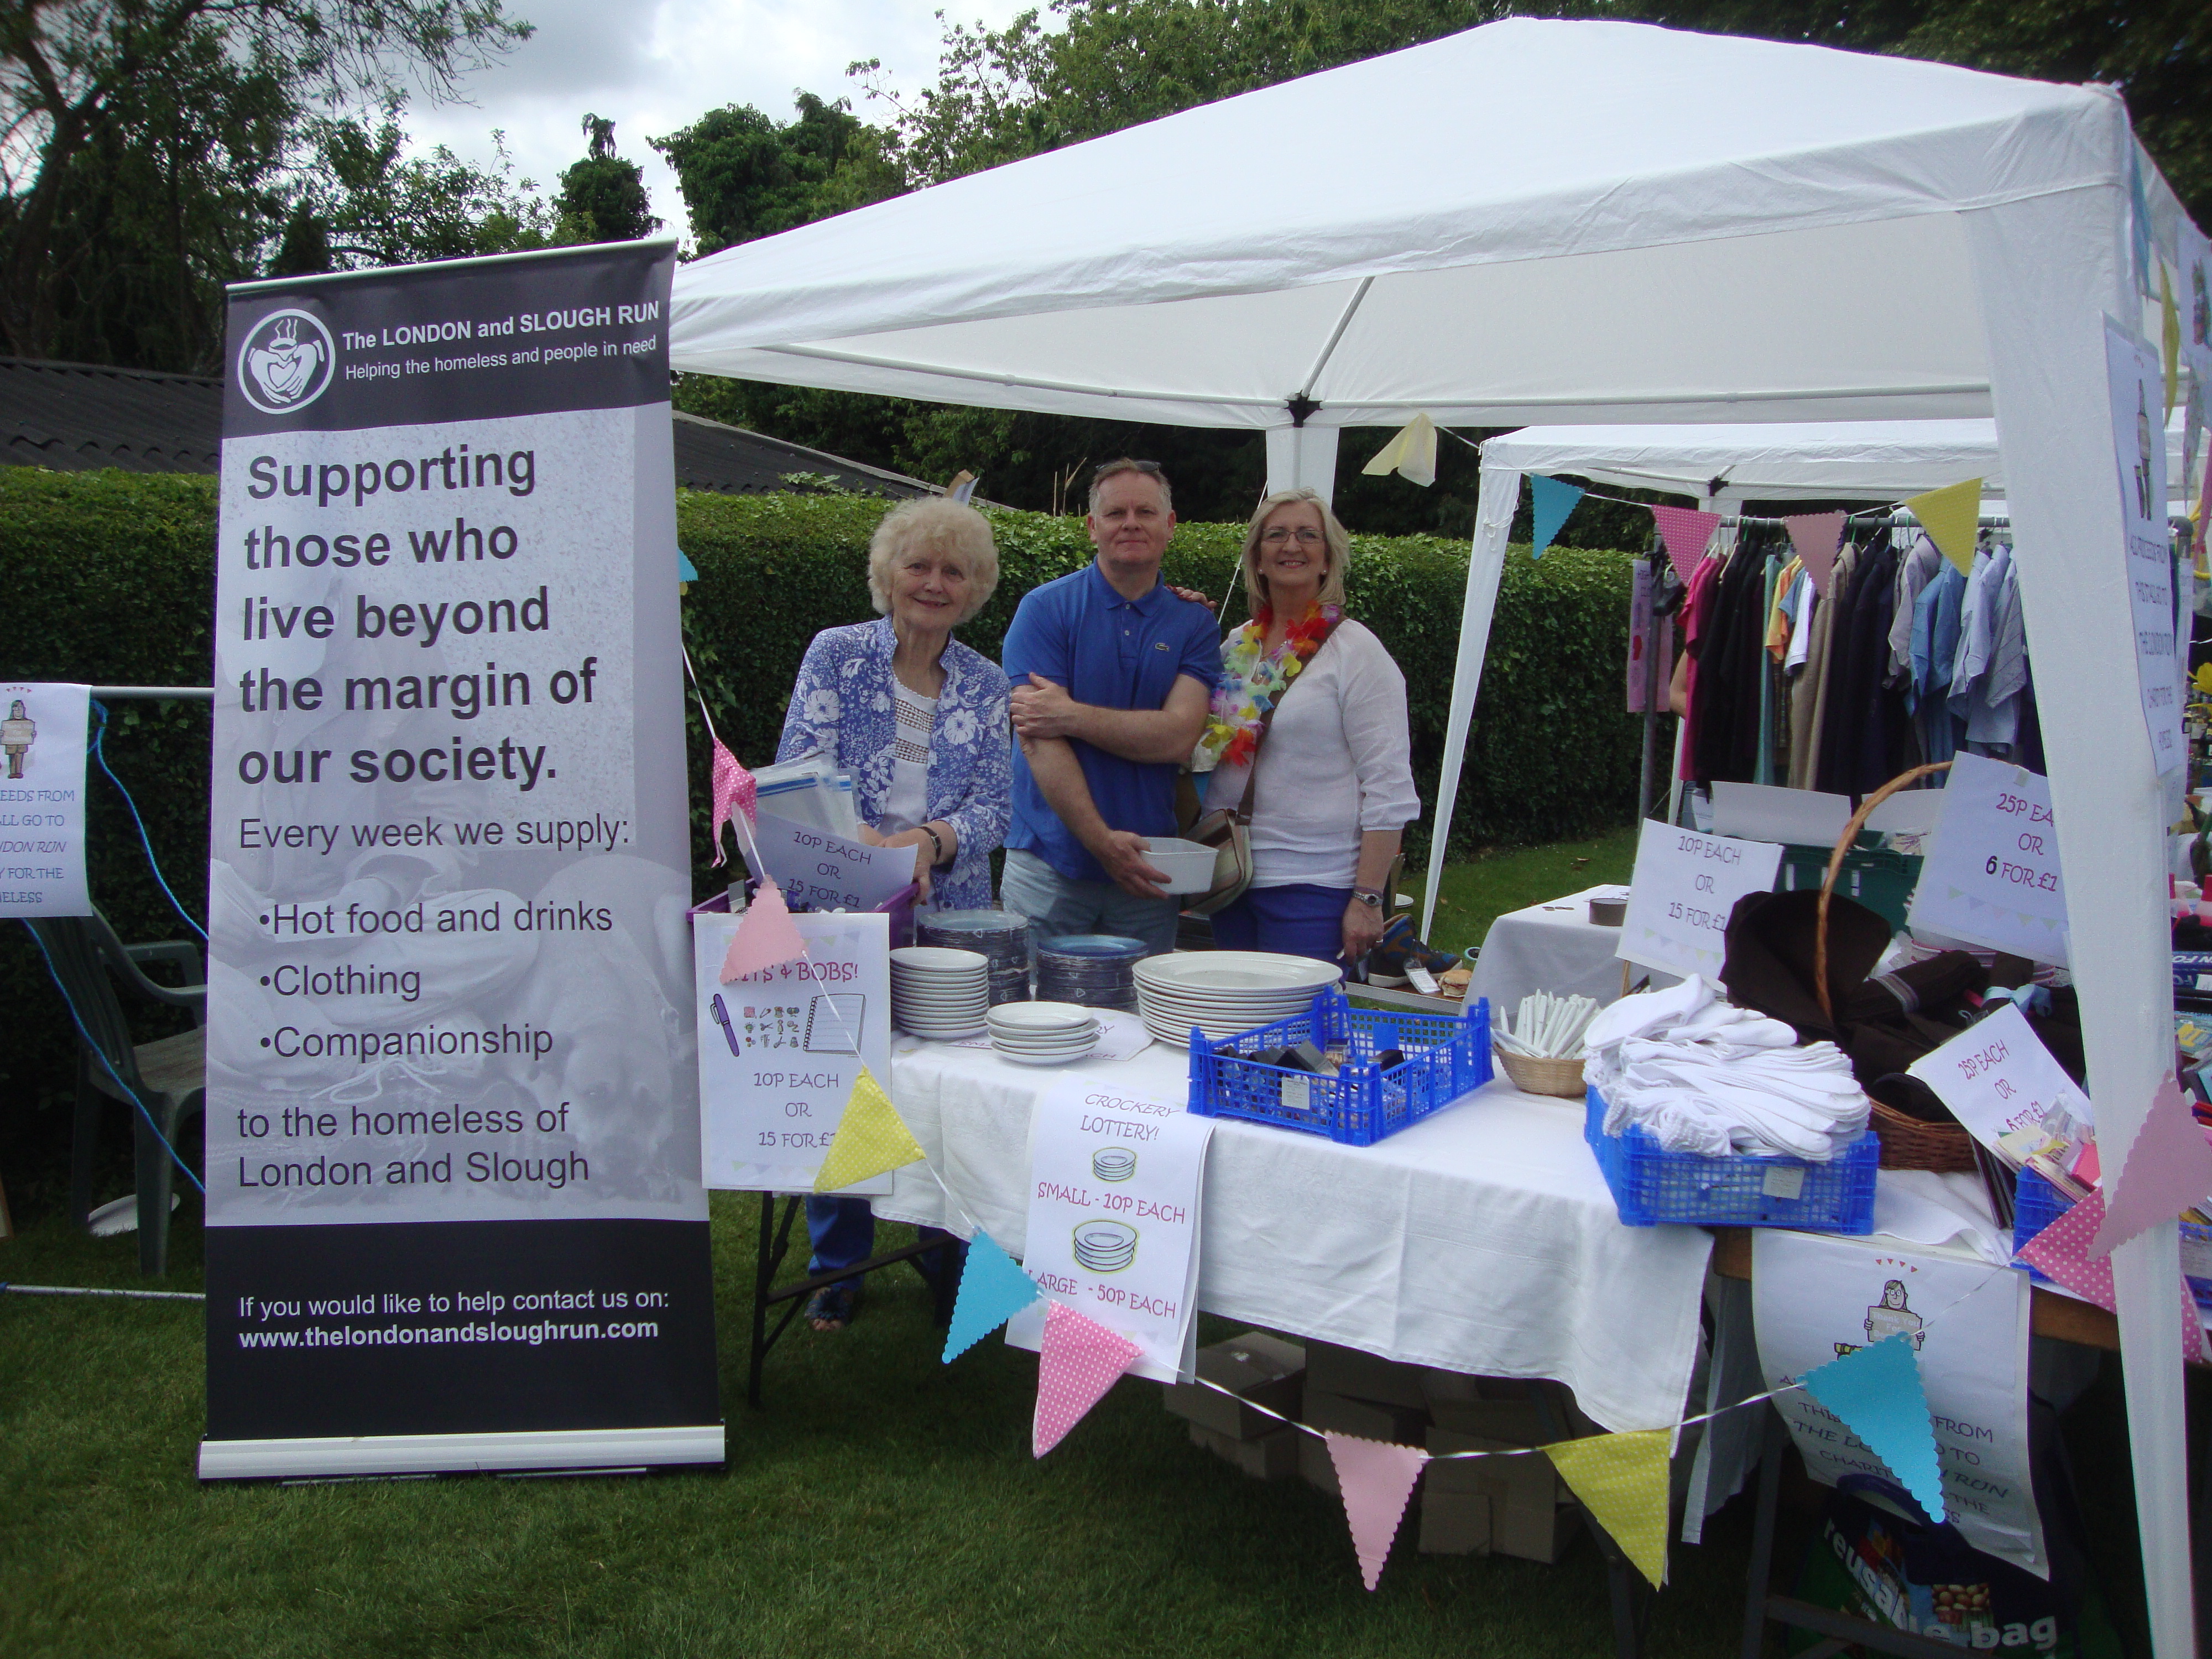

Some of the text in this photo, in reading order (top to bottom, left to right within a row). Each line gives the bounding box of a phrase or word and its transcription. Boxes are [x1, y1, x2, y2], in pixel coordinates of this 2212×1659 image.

[342, 300, 660, 351] The LONDON and SLOUGH RUN
[346, 335, 657, 380] Helping the homeless and people in need
[248, 444, 535, 508] Supporting
[244, 517, 518, 570] those who
[243, 586, 549, 648] live beyond
[239, 656, 597, 719] the margin of
[239, 736, 556, 792] our society.
[38, 790, 75, 802] FROM
[1996, 792, 2027, 817] 25P
[0, 815, 65, 826] LL GO TO
[239, 813, 629, 855] Every week we supply:
[37, 841, 67, 853] RUN
[793, 831, 872, 864] 10P EACH
[1678, 836, 1741, 865] 10P EACH
[2018, 833, 2044, 855] OR
[8, 868, 35, 879] FOR
[36, 868, 64, 879] THE
[817, 863, 841, 879] OR
[1695, 874, 1714, 894] OR
[1986, 855, 2058, 891] 6 FOR £1
[0, 892, 43, 904] ELESS
[788, 879, 860, 908] 15 FOR £1
[274, 900, 613, 935] Hot food and drinks
[1668, 902, 1726, 932] 15 FOR £1
[274, 964, 421, 1002] Clothing
[795, 961, 858, 983] BOBS!
[274, 1023, 553, 1063] Companionship
[1974, 1039, 2010, 1071] EACH
[754, 1072, 839, 1088] 10P EACH
[1994, 1078, 2017, 1099] OR
[238, 1102, 571, 1138] to the homeless of
[785, 1102, 812, 1117] OR
[1084, 1093, 1181, 1118] CROCKERY
[759, 1131, 776, 1146] 15
[781, 1133, 818, 1148] FOR
[1080, 1115, 1160, 1141] LOTTERY!
[239, 1150, 589, 1189] London and Slough
[1037, 1181, 1092, 1208] SMALL
[1103, 1192, 1134, 1211] 10P
[1136, 1200, 1186, 1225] EACH
[239, 1290, 670, 1321] If you would like to help contact us on:
[1097, 1284, 1126, 1306] 50P
[1130, 1293, 1177, 1320] EACH
[239, 1319, 659, 1348] www.thelondonandsloughrun.com
[1793, 1421, 1837, 1442] THE
[1950, 1447, 1980, 1465] TO
[1933, 1415, 1993, 1443] FROM
[1954, 1472, 2008, 1499] RUN
[1949, 1493, 1990, 1515] THE
[1970, 1615, 2057, 1650] bag
